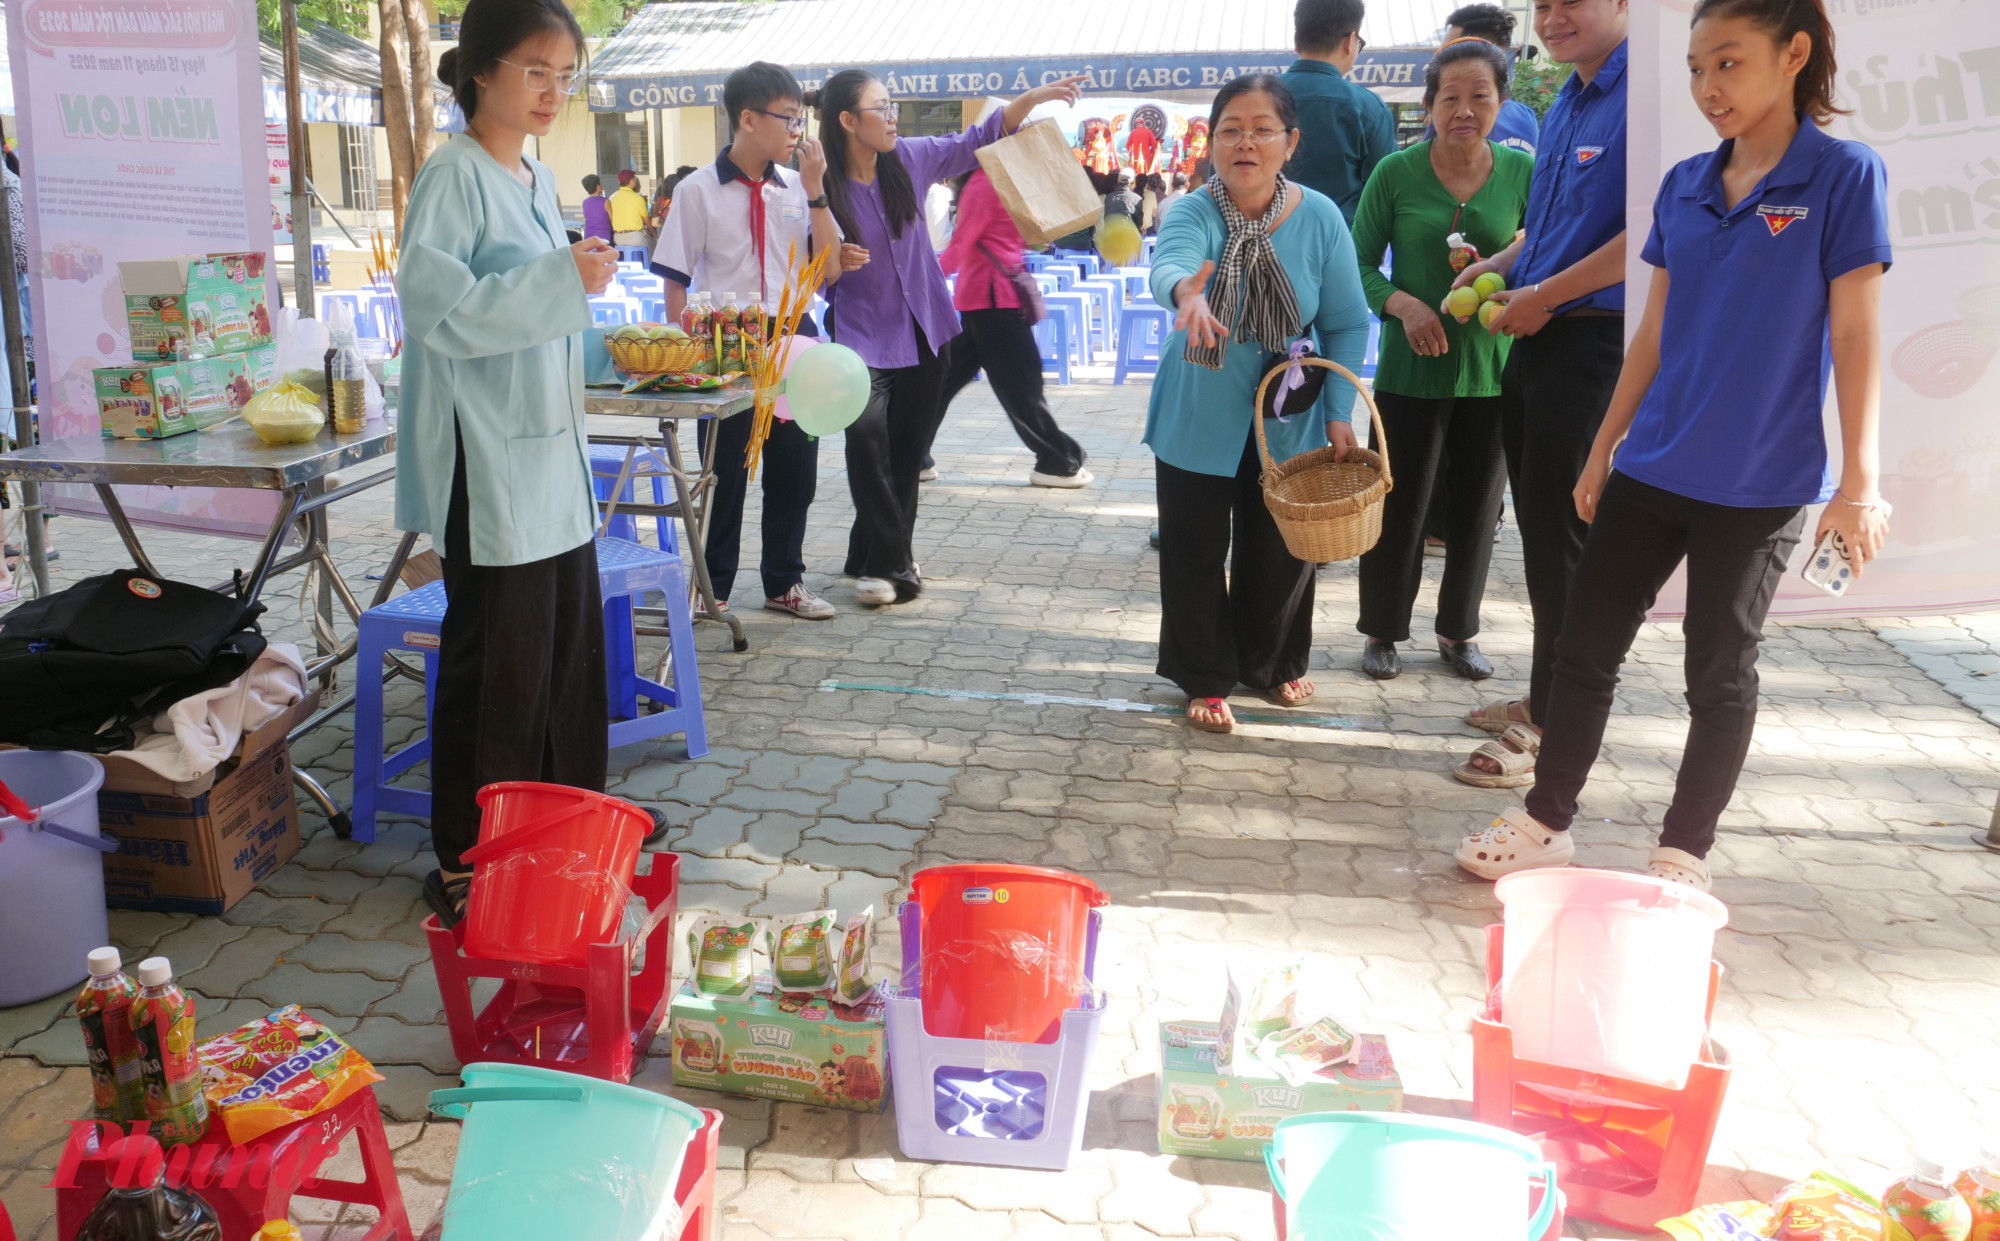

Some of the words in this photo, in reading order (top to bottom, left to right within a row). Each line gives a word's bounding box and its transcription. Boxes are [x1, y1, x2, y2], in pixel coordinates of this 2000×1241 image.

[629, 83, 697, 106] CÔNG
[704, 84, 725, 102] T
[885, 71, 938, 94] ÁNH
[947, 72, 1003, 96] KẸO
[1011, 66, 1031, 91] Á
[1126, 66, 1191, 90] (ABC
[257, 816, 288, 849] Hàng
[104, 832, 192, 867] Hàn
[233, 843, 259, 872] Việt
[106, 885, 147, 900] NamD
[997, 891, 1007, 901] 10
[218, 1037, 343, 1106] mentos
[733, 1061, 785, 1077] SƯƠNG
[785, 1066, 817, 1083] SÁO
